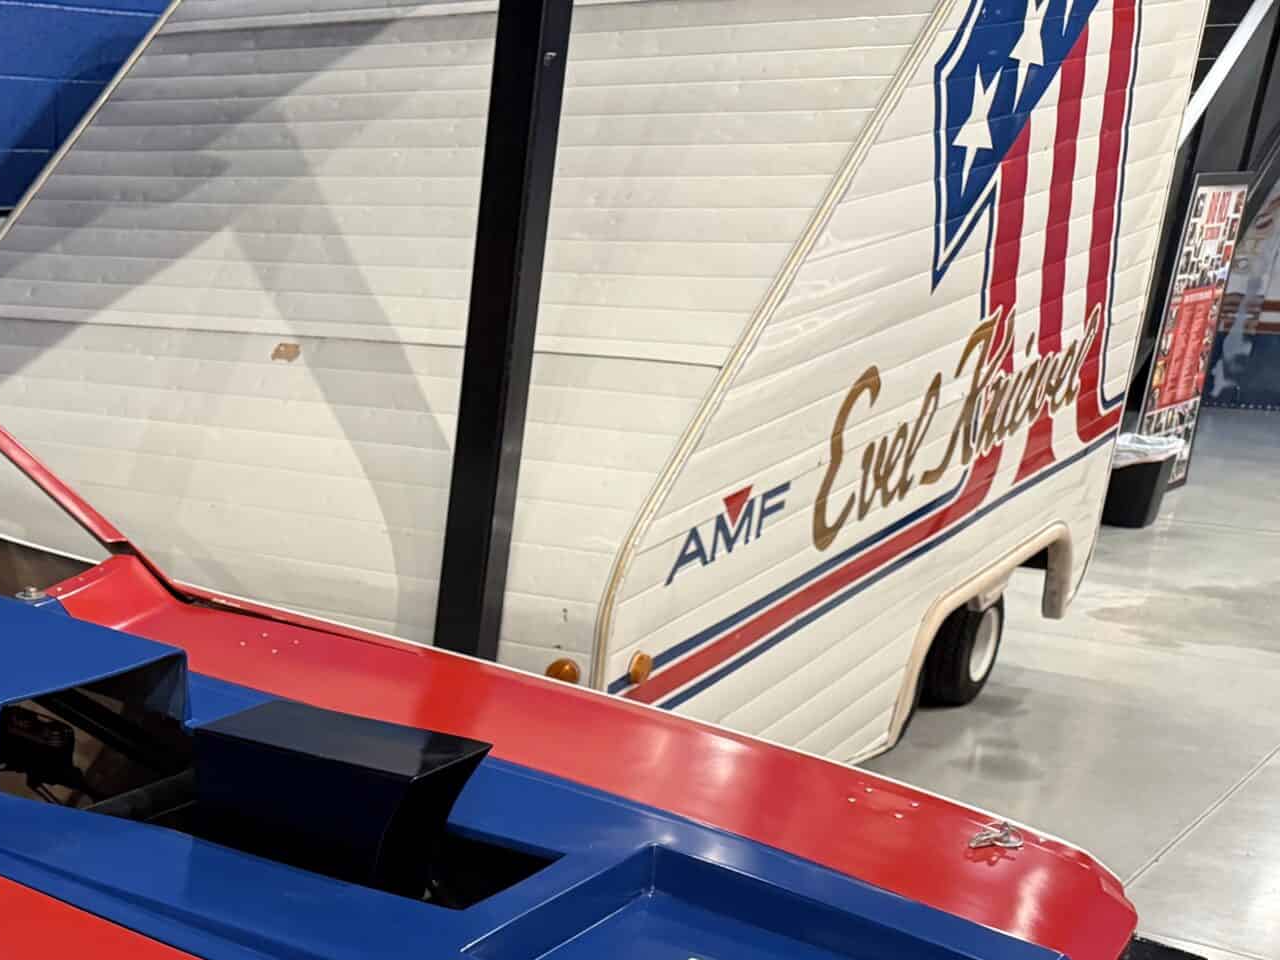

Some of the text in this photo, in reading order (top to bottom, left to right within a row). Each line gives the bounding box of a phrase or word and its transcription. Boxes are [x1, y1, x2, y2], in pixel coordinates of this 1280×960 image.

[811, 365, 942, 552] Evel
[920, 302, 1103, 485] Knievel
[664, 480, 791, 586] AMF
